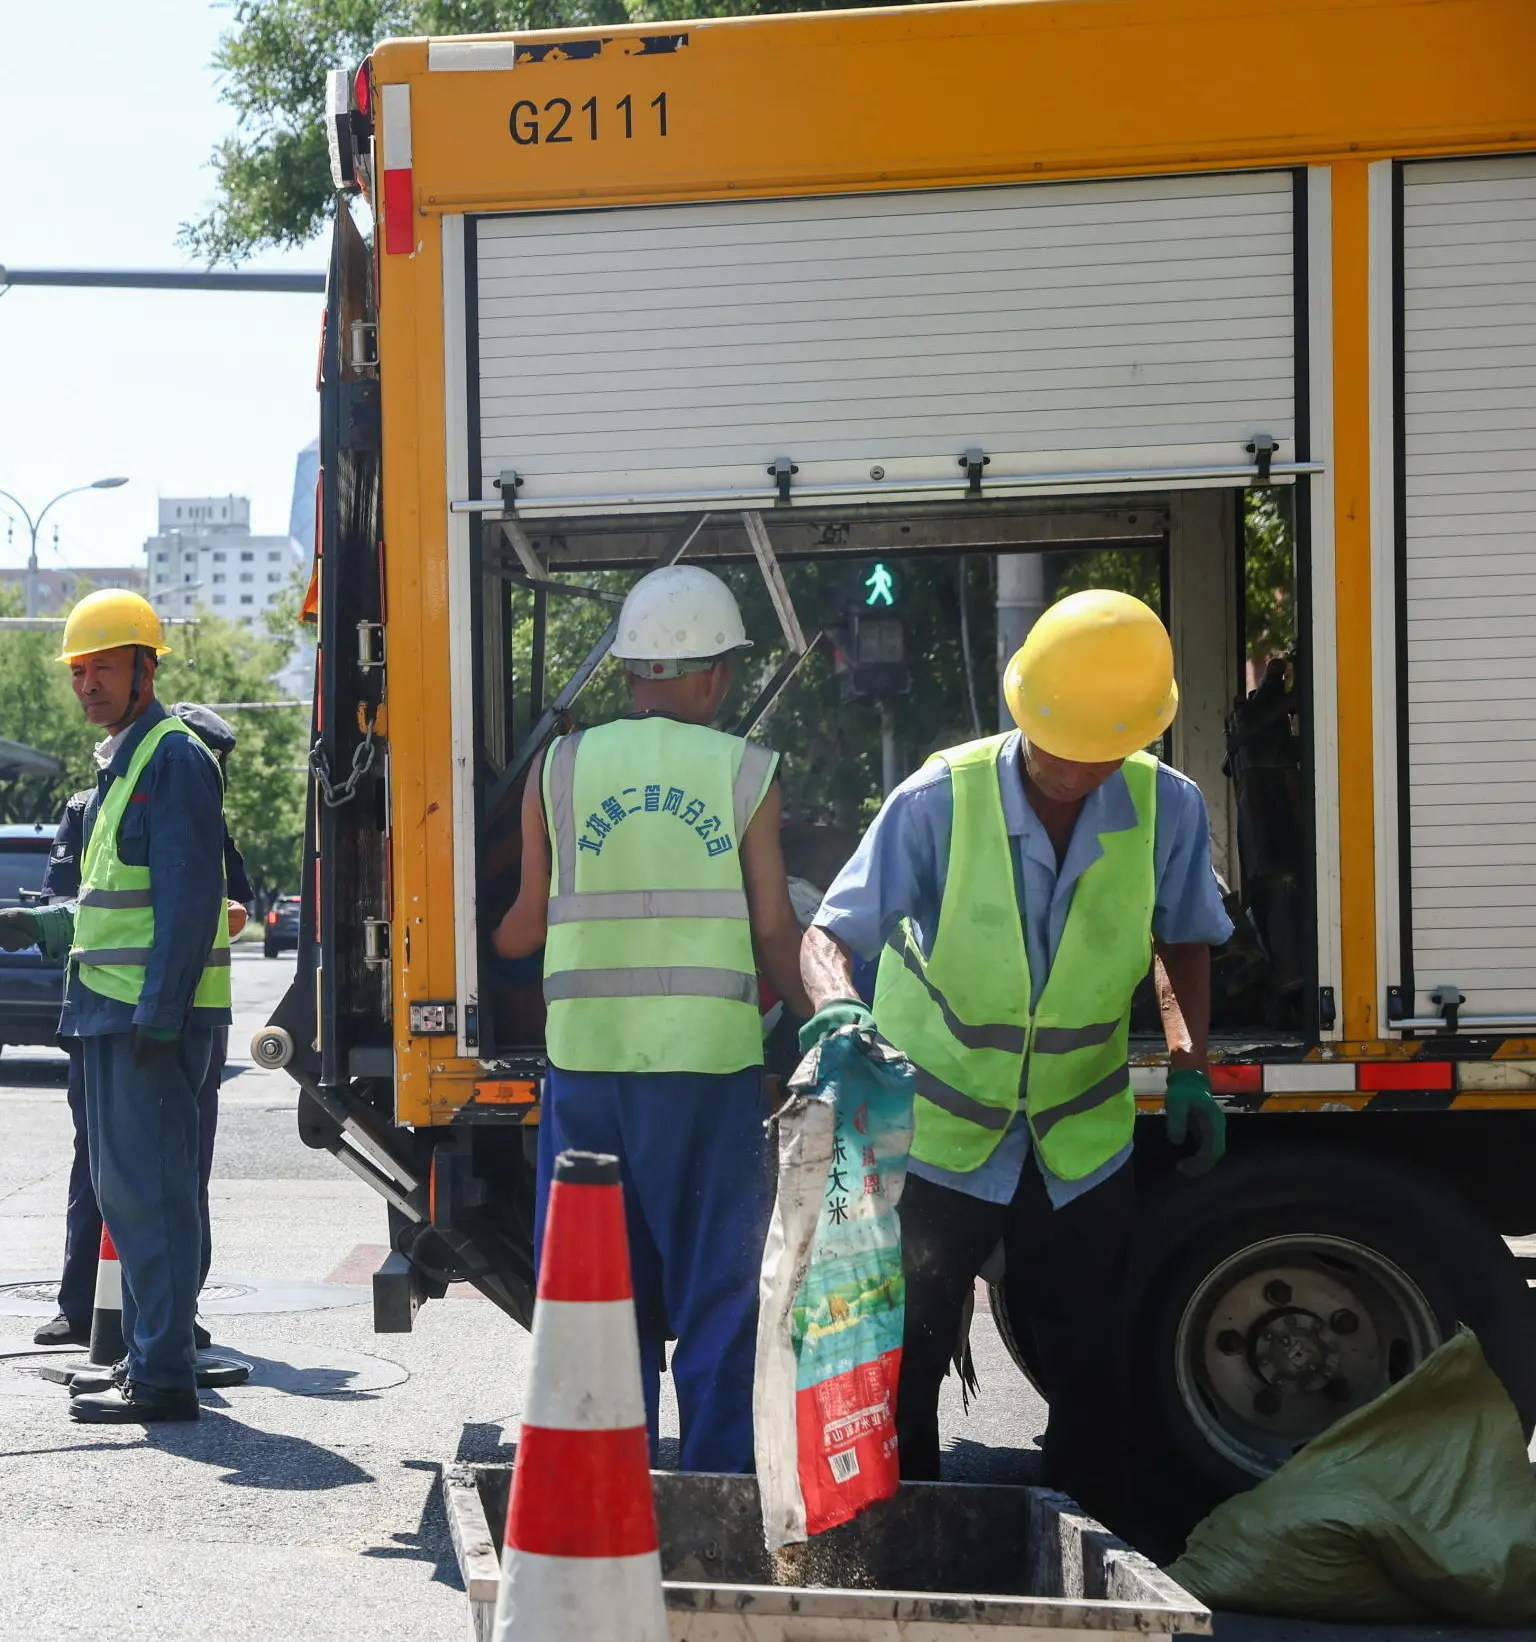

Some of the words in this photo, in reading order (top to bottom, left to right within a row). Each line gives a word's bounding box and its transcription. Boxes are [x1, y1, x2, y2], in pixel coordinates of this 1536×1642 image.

[509, 91, 667, 146] G2111
[577, 784, 733, 858] 北排第二管网分公司
